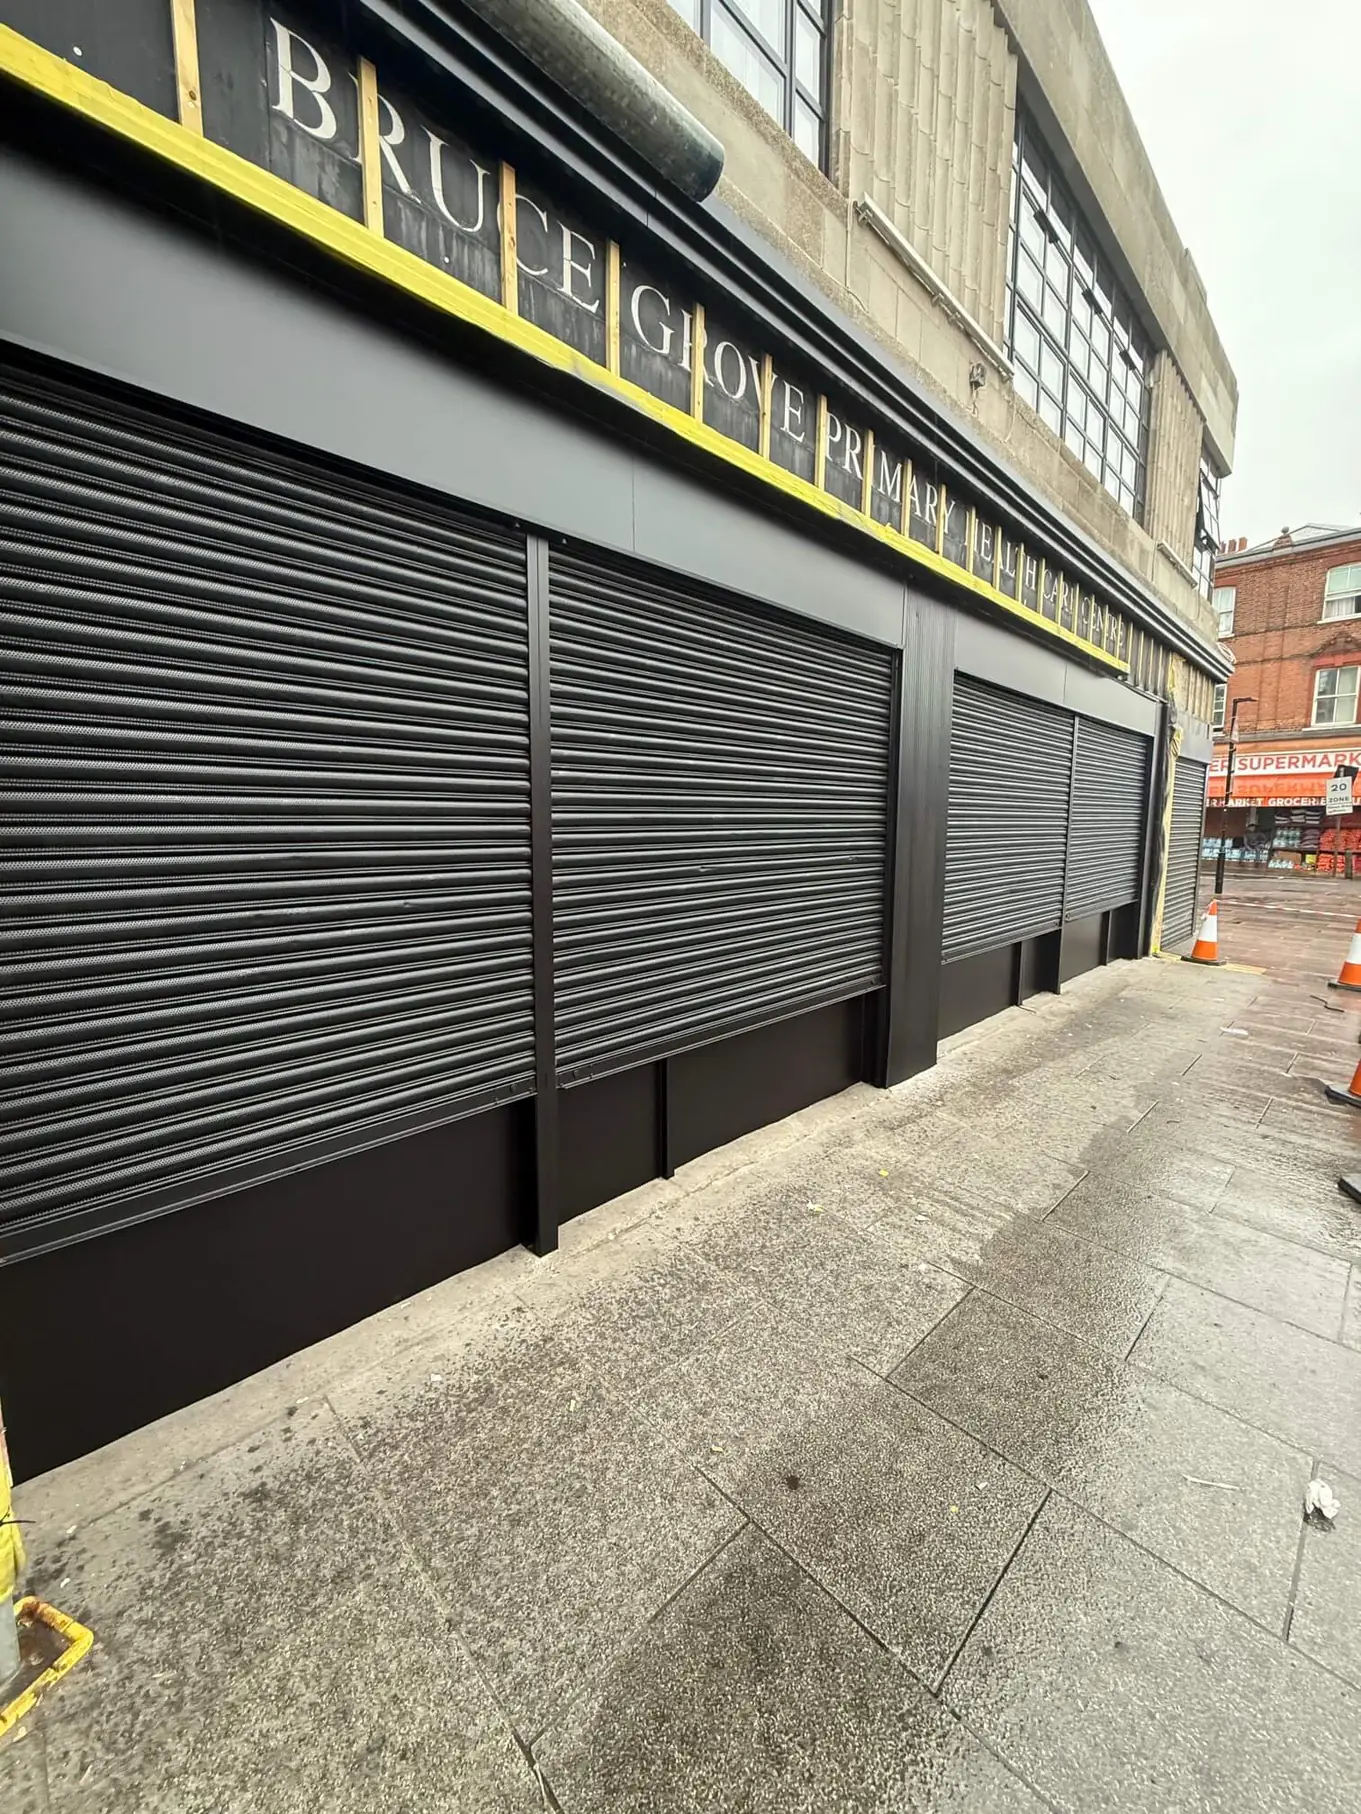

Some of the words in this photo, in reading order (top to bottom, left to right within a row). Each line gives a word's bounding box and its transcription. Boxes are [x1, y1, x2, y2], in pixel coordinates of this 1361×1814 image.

[269, 17, 601, 313] BRUCE
[631, 285, 806, 443] GROVE
[825, 412, 956, 534] PRMARY
[1238, 752, 1361, 770] SUPERMARK
[1331, 783, 1347, 792] 20
[1268, 797, 1326, 807] GROCERIE
